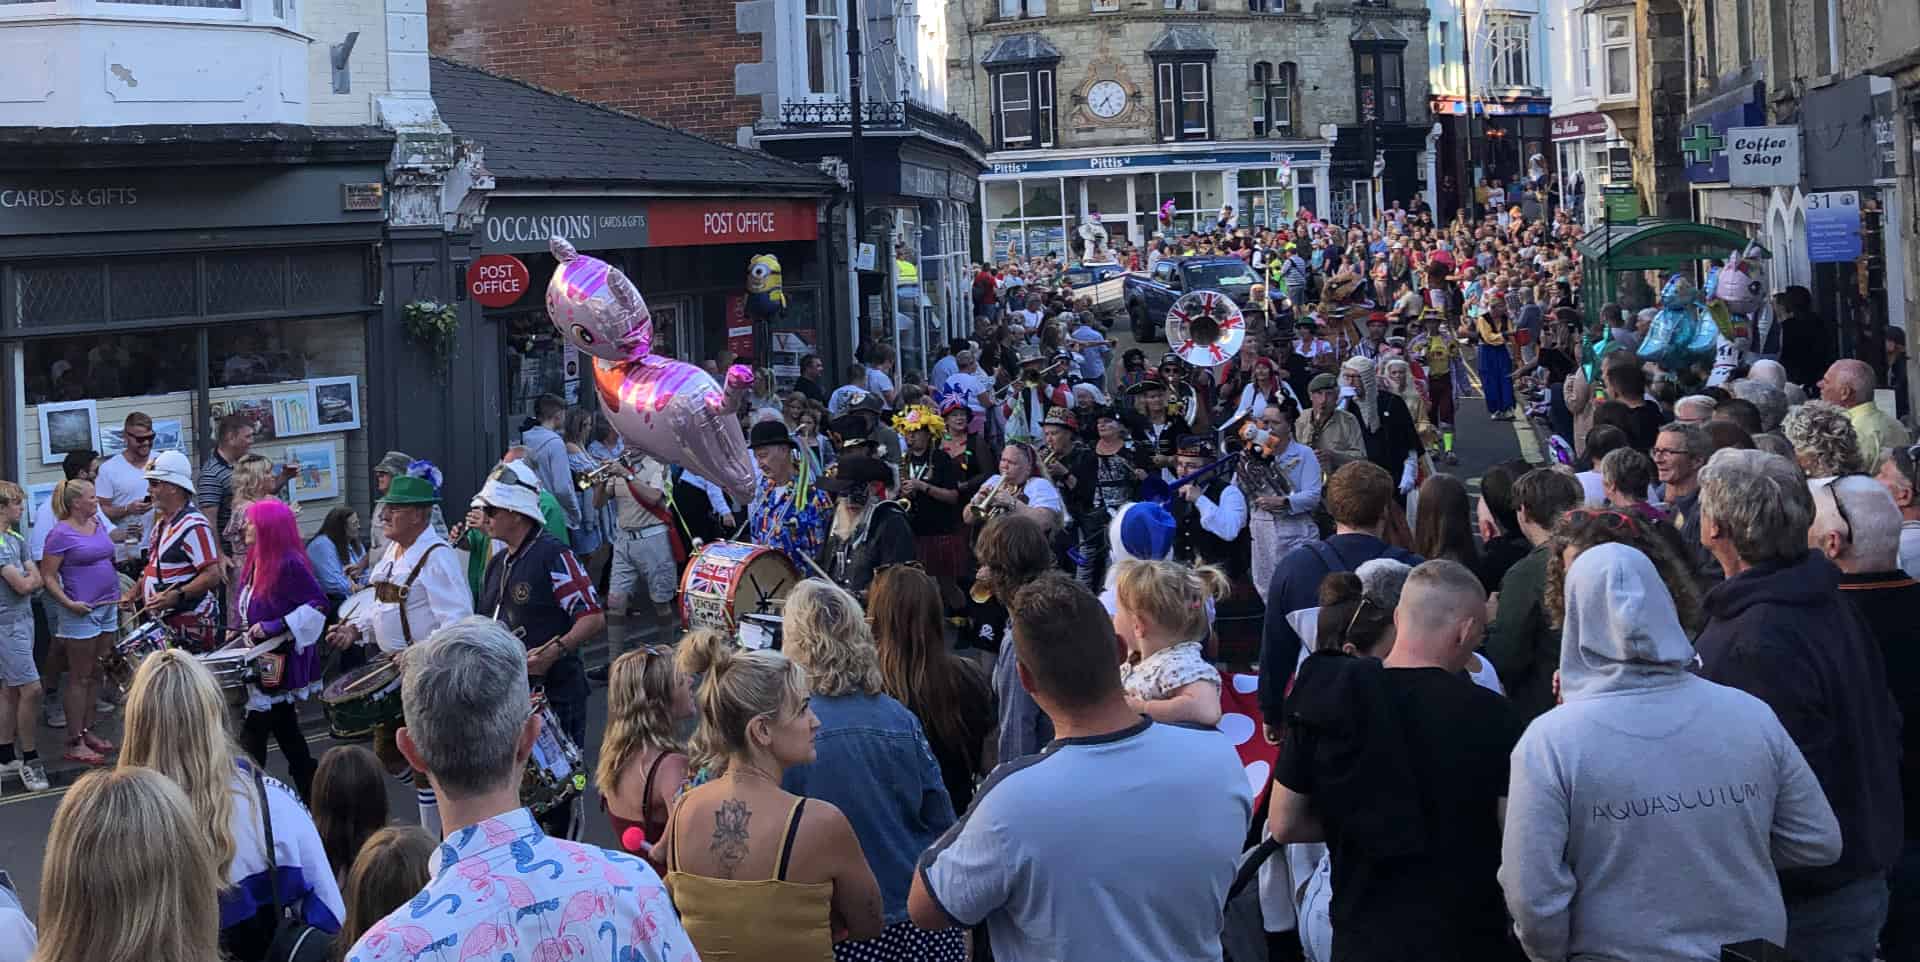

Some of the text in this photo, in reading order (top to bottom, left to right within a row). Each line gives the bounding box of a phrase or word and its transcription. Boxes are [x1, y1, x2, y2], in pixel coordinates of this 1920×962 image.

[1735, 136, 1786, 151] Coffee
[1091, 158, 1122, 168] Pittis
[1743, 153, 1782, 166] Shop
[994, 163, 1021, 173] Pittis
[0, 188, 137, 207] CARDS & GIFTS
[1807, 193, 1830, 210] 31
[487, 215, 590, 242] OCCASIONS
[704, 213, 733, 235] POST
[736, 212, 775, 233] OFFICE
[480, 264, 513, 279] POST
[472, 279, 520, 294] OFFICE
[1592, 783, 1761, 824] AQUASCUTUM
